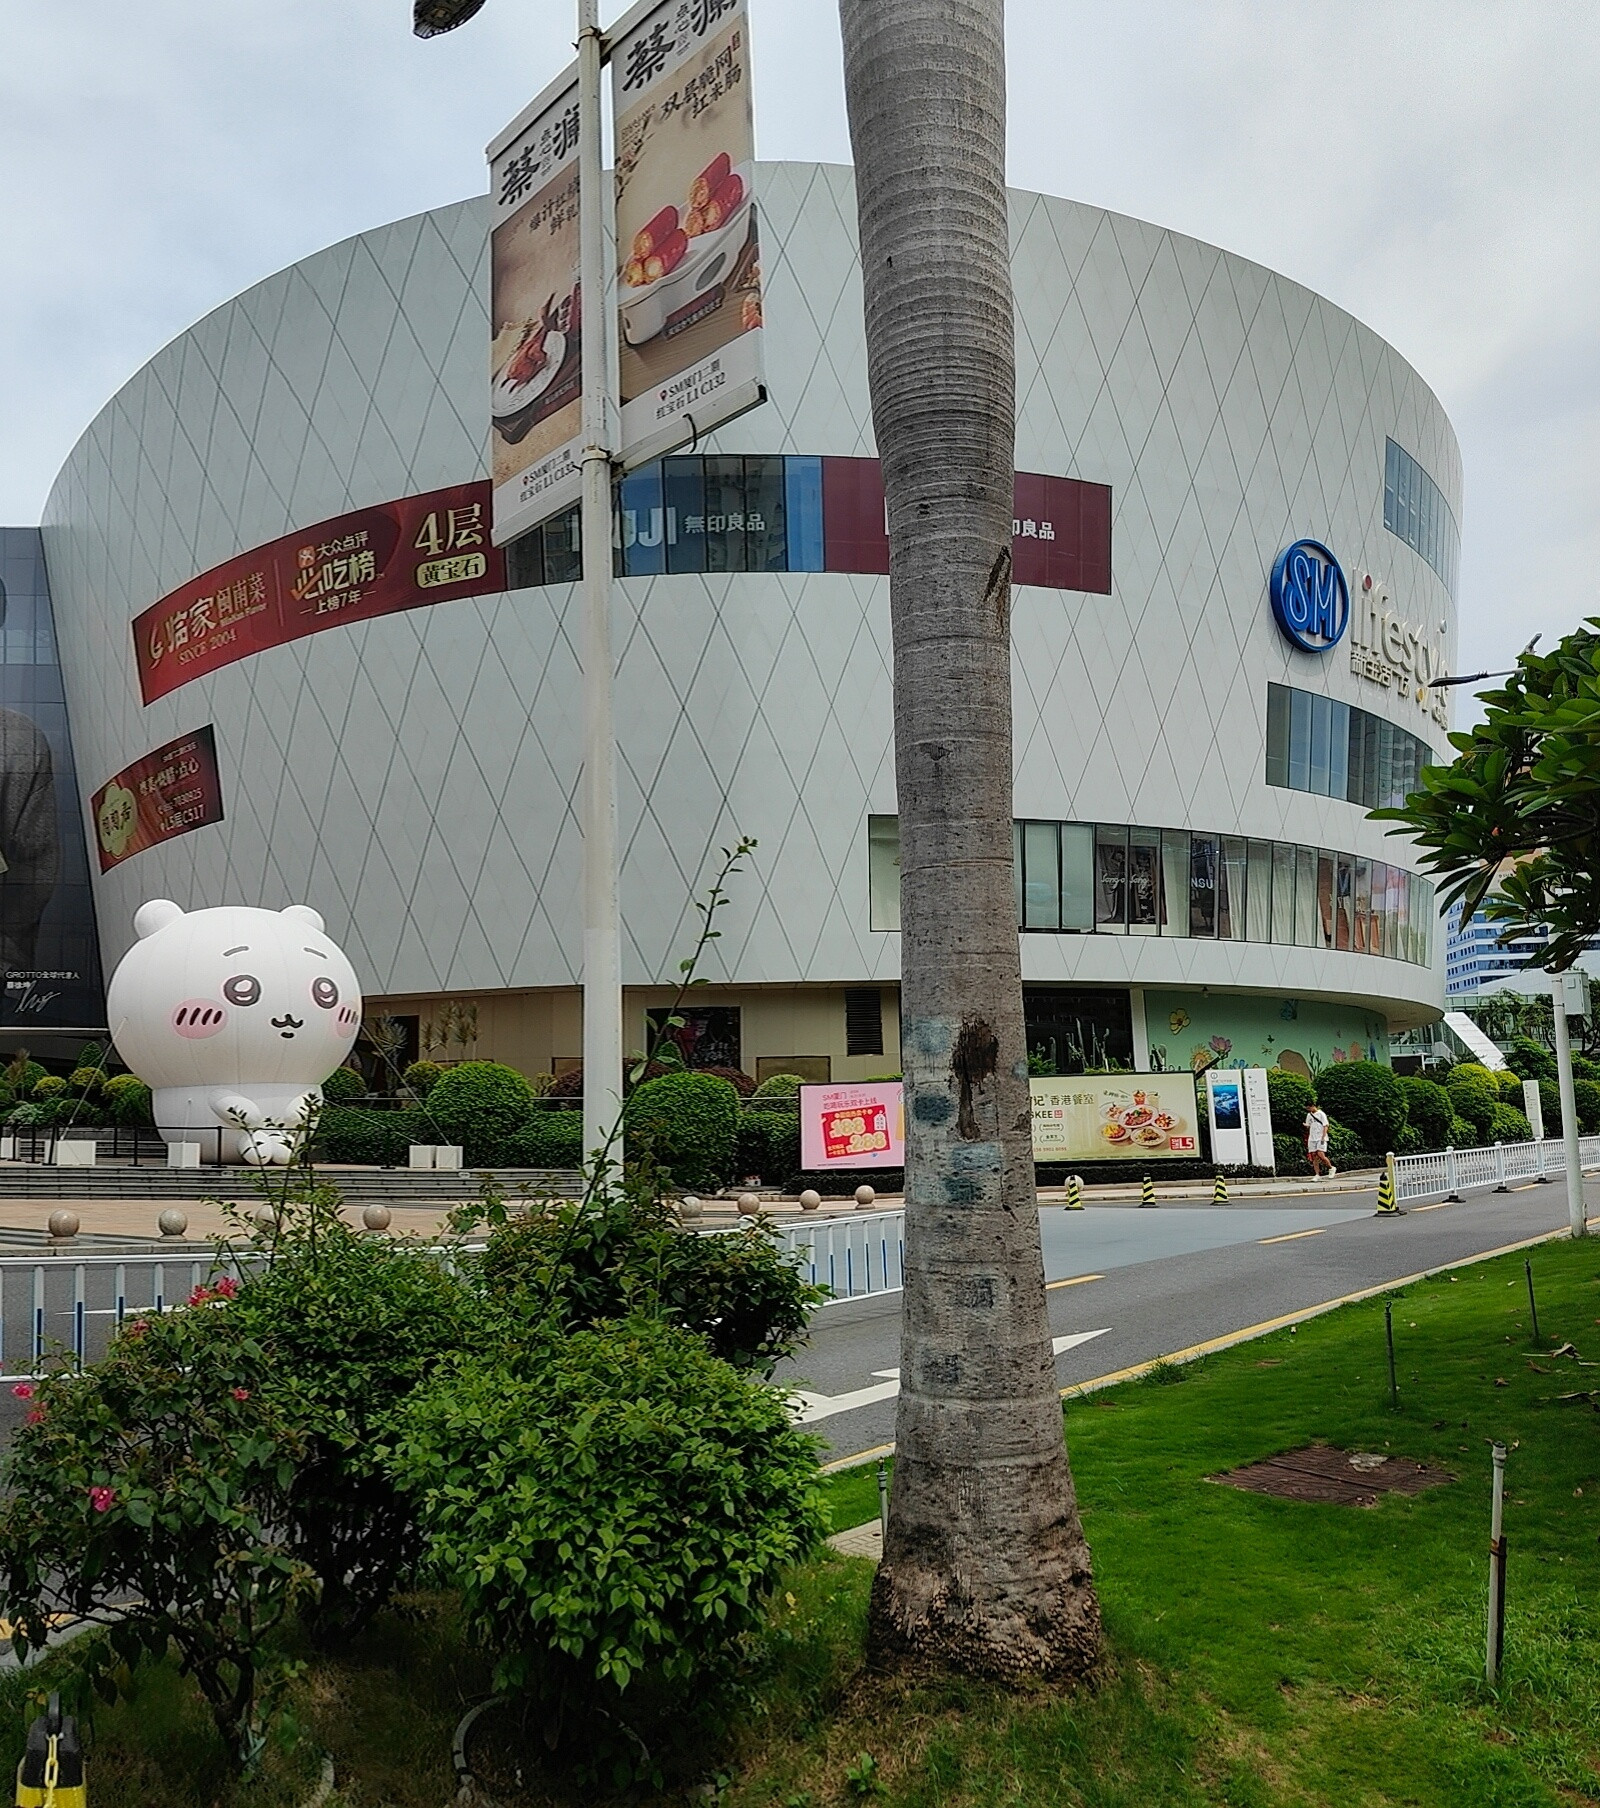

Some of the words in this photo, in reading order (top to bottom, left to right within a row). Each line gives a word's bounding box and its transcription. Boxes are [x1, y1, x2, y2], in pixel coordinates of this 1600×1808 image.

[414, 502, 485, 556] 4层
[684, 512, 766, 534] 無印良品
[316, 530, 370, 561] 大众点评
[291, 550, 375, 600] 必吃榜
[423, 555, 481, 586] 黄宝石
[217, 571, 267, 619] 闽南菜
[314, 589, 363, 615] 上榜7年
[178, 641, 208, 666] SINCE
[1179, 1137, 1194, 1150] L5
